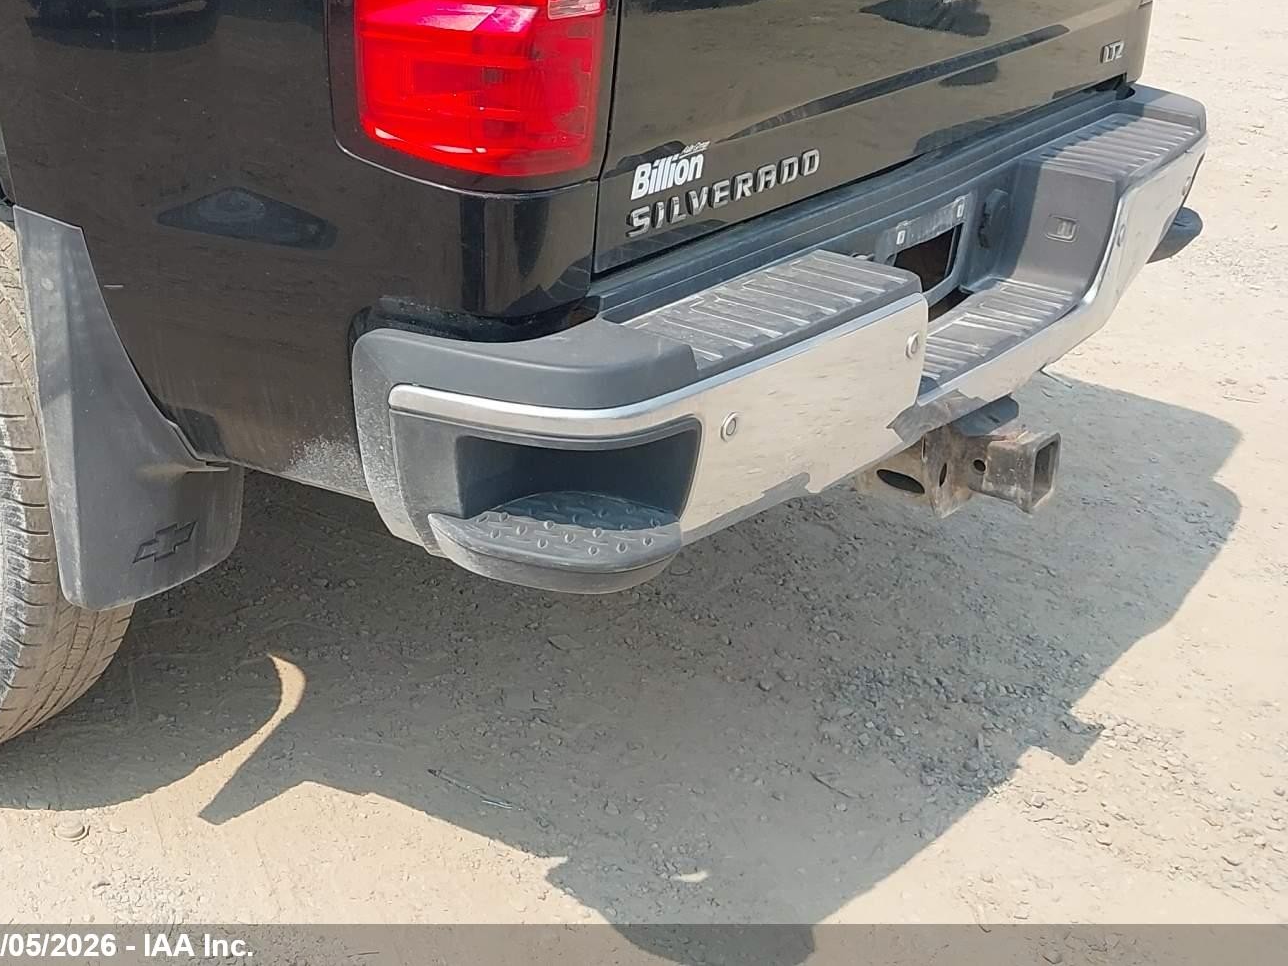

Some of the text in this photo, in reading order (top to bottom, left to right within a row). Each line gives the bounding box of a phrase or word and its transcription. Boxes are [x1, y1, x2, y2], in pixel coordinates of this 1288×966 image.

[1101, 40, 1124, 63] LTZ
[626, 148, 821, 238] SILVERADO
[630, 152, 704, 201] Billion
